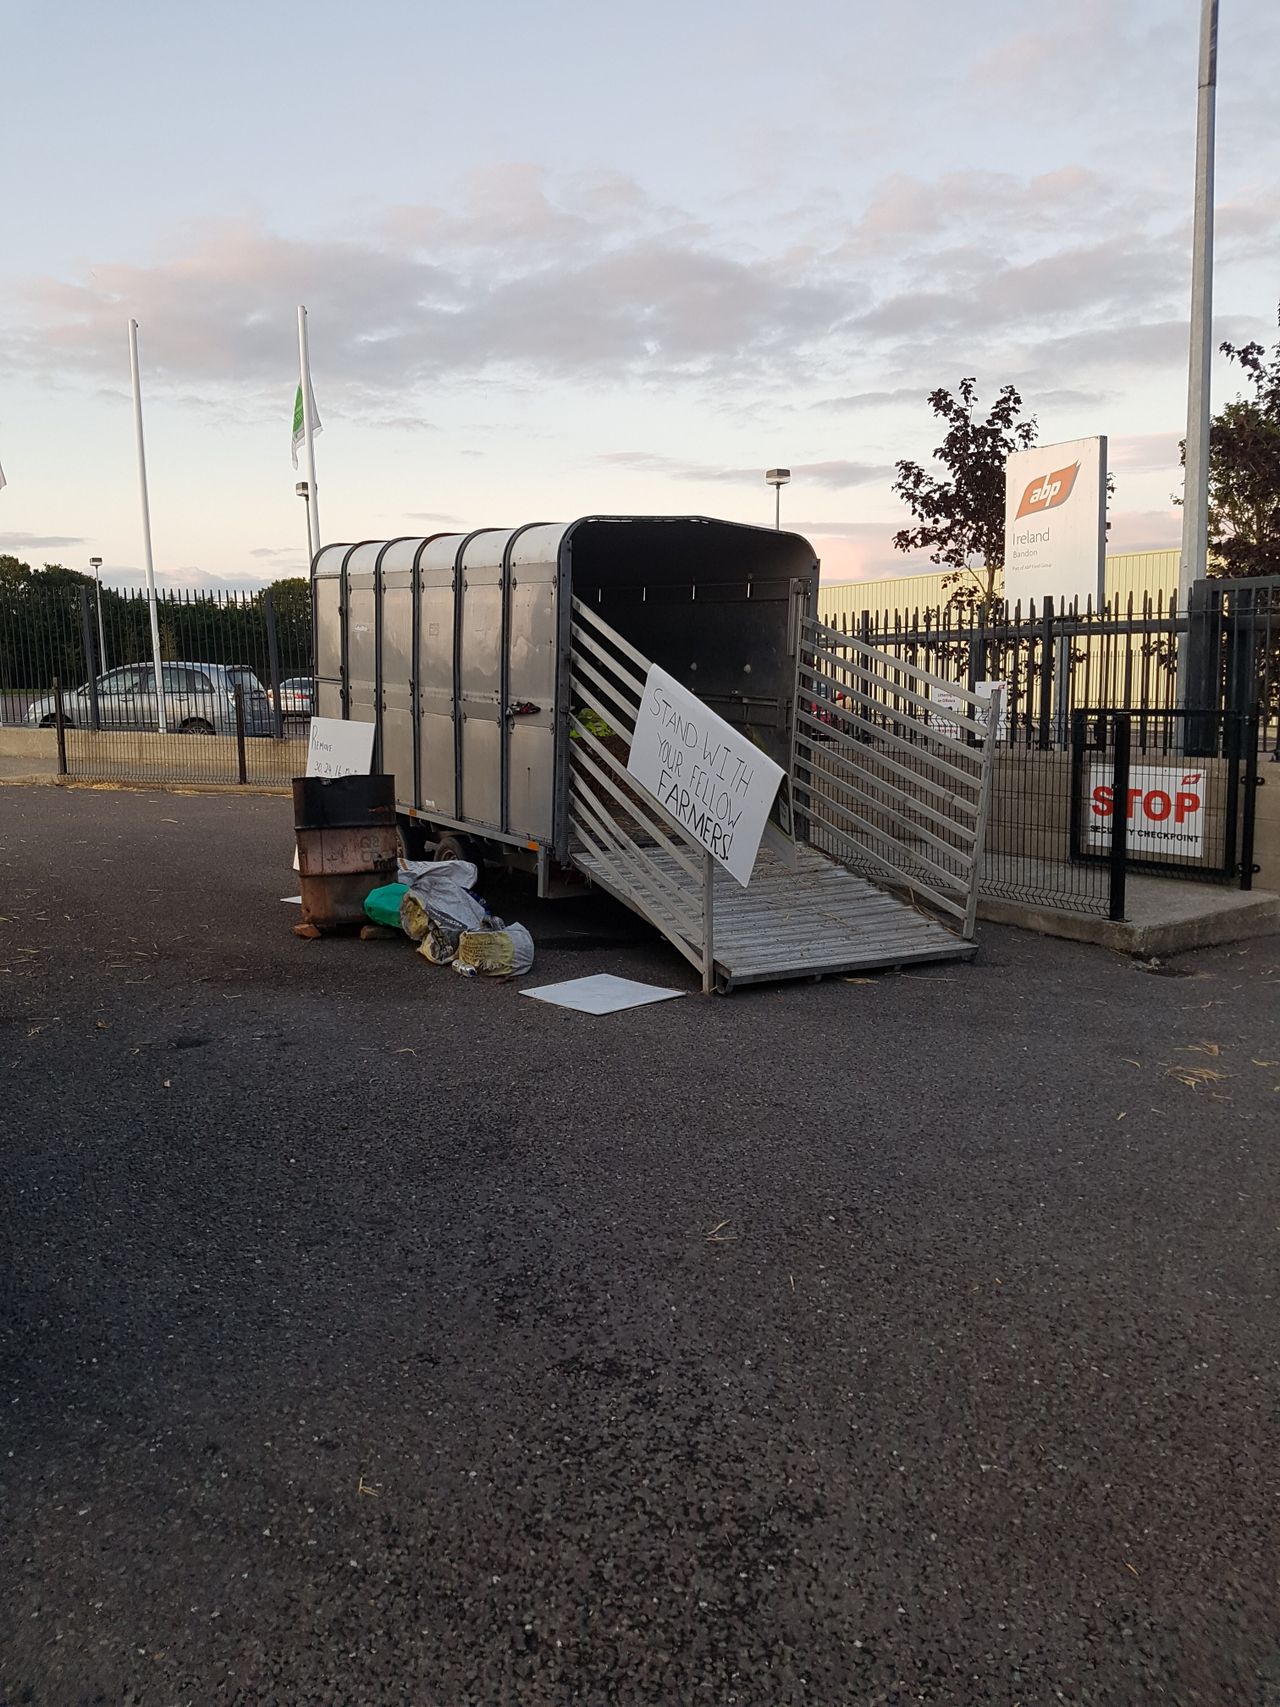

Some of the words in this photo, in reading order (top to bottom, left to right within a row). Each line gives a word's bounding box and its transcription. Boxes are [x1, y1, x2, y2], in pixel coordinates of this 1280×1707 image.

[1029, 471, 1062, 507] abp
[1012, 527, 1050, 546] Ireland
[1012, 550, 1038, 559] Bandon
[650, 688, 698, 748] STAND
[702, 731, 754, 798] WITH
[657, 732, 683, 777] YOUR
[689, 764, 743, 829] FELLOW
[657, 769, 734, 861] FARMERS!
[1092, 786, 1200, 823] STOP
[1137, 830, 1200, 843] CHECKPOINT
